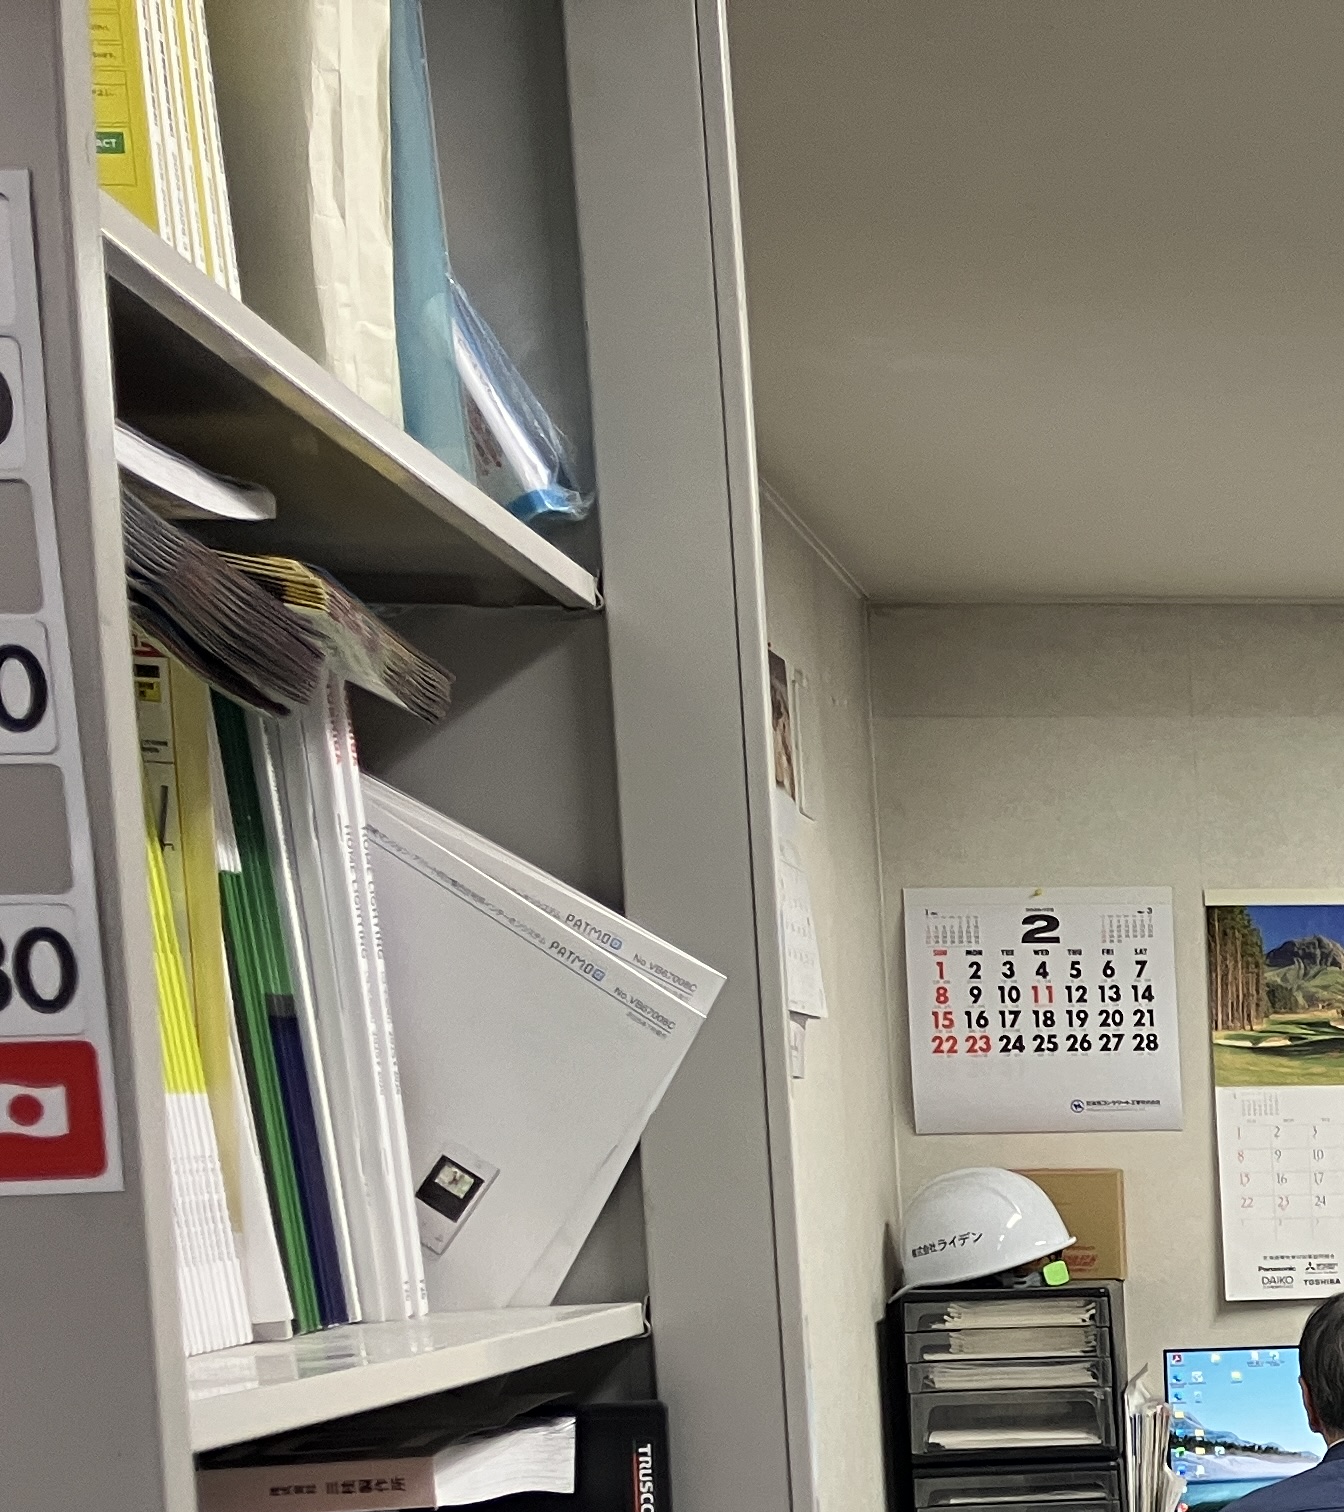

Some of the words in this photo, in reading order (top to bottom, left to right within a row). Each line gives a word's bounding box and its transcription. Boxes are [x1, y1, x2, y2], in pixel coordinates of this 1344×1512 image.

[1021, 914, 1060, 944] 2
[936, 961, 944, 980] 1
[968, 961, 981, 979] 2
[1002, 960, 1015, 979] 3
[1035, 961, 1049, 979] 4
[1070, 961, 1081, 979] 5
[1102, 960, 1115, 978] 6
[1135, 960, 1148, 978] 7
[935, 986, 949, 1004] 8
[969, 986, 982, 1004] 9
[998, 985, 1021, 1004] 10
[1031, 985, 1053, 1003] 11
[1065, 985, 1087, 1003] 12
[1098, 984, 1121, 1003] 13
[1131, 984, 1155, 1002] 14
[932, 1011, 954, 1030] 15
[964, 1010, 989, 1029] 16
[998, 1010, 1021, 1028] 17
[1032, 1010, 1055, 1028] 18
[1066, 1010, 1089, 1028] 19
[1098, 1009, 1123, 1027] 20
[1133, 1009, 1154, 1027] 21
[931, 1035, 958, 1054] 22
[965, 1035, 991, 1053] 23
[999, 1035, 1025, 1053] 24
[1032, 1034, 1058, 1053] 25
[1066, 1034, 1092, 1052] 26
[1099, 1033, 1125, 1051] 27
[1132, 1033, 1159, 1051] 28
[1303, 1278, 1341, 1286] TOSHIBA
